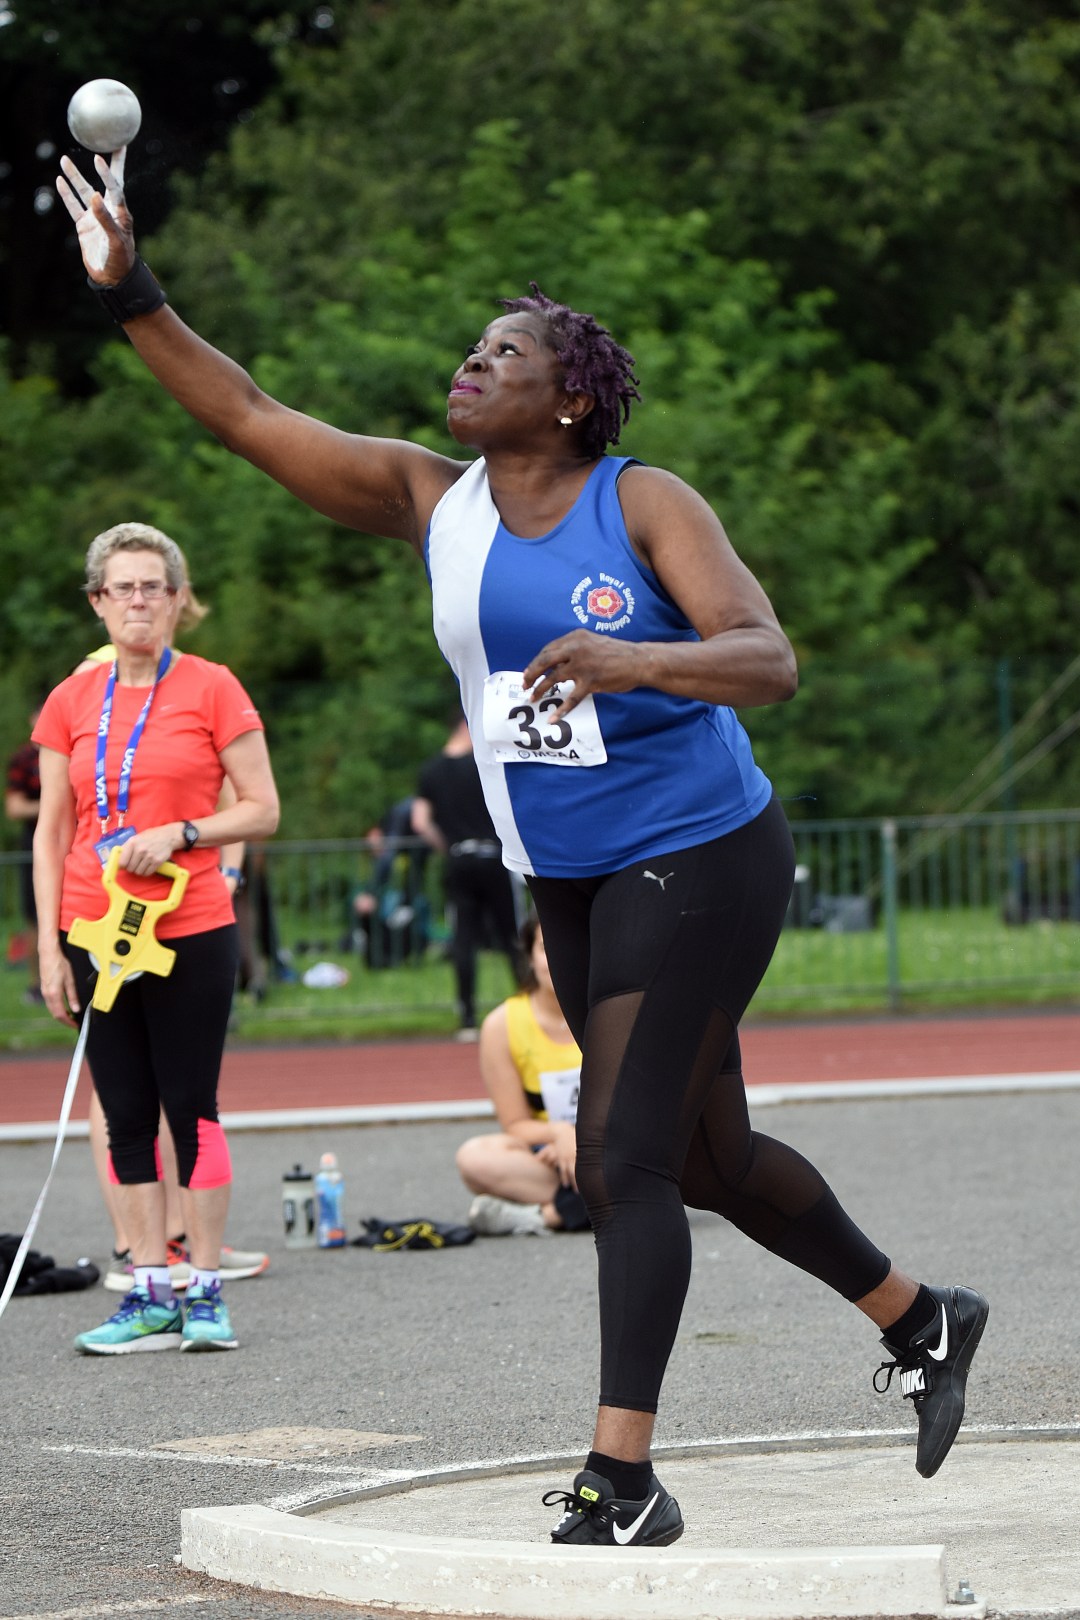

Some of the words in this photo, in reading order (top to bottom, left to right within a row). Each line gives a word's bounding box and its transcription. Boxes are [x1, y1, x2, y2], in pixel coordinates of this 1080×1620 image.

[599, 572, 625, 589] Royal
[573, 605, 589, 624] Club
[508, 697, 573, 750] 33
[121, 747, 136, 776] UKA
[96, 775, 109, 807] UKA
[900, 1367, 926, 1396] NIK
